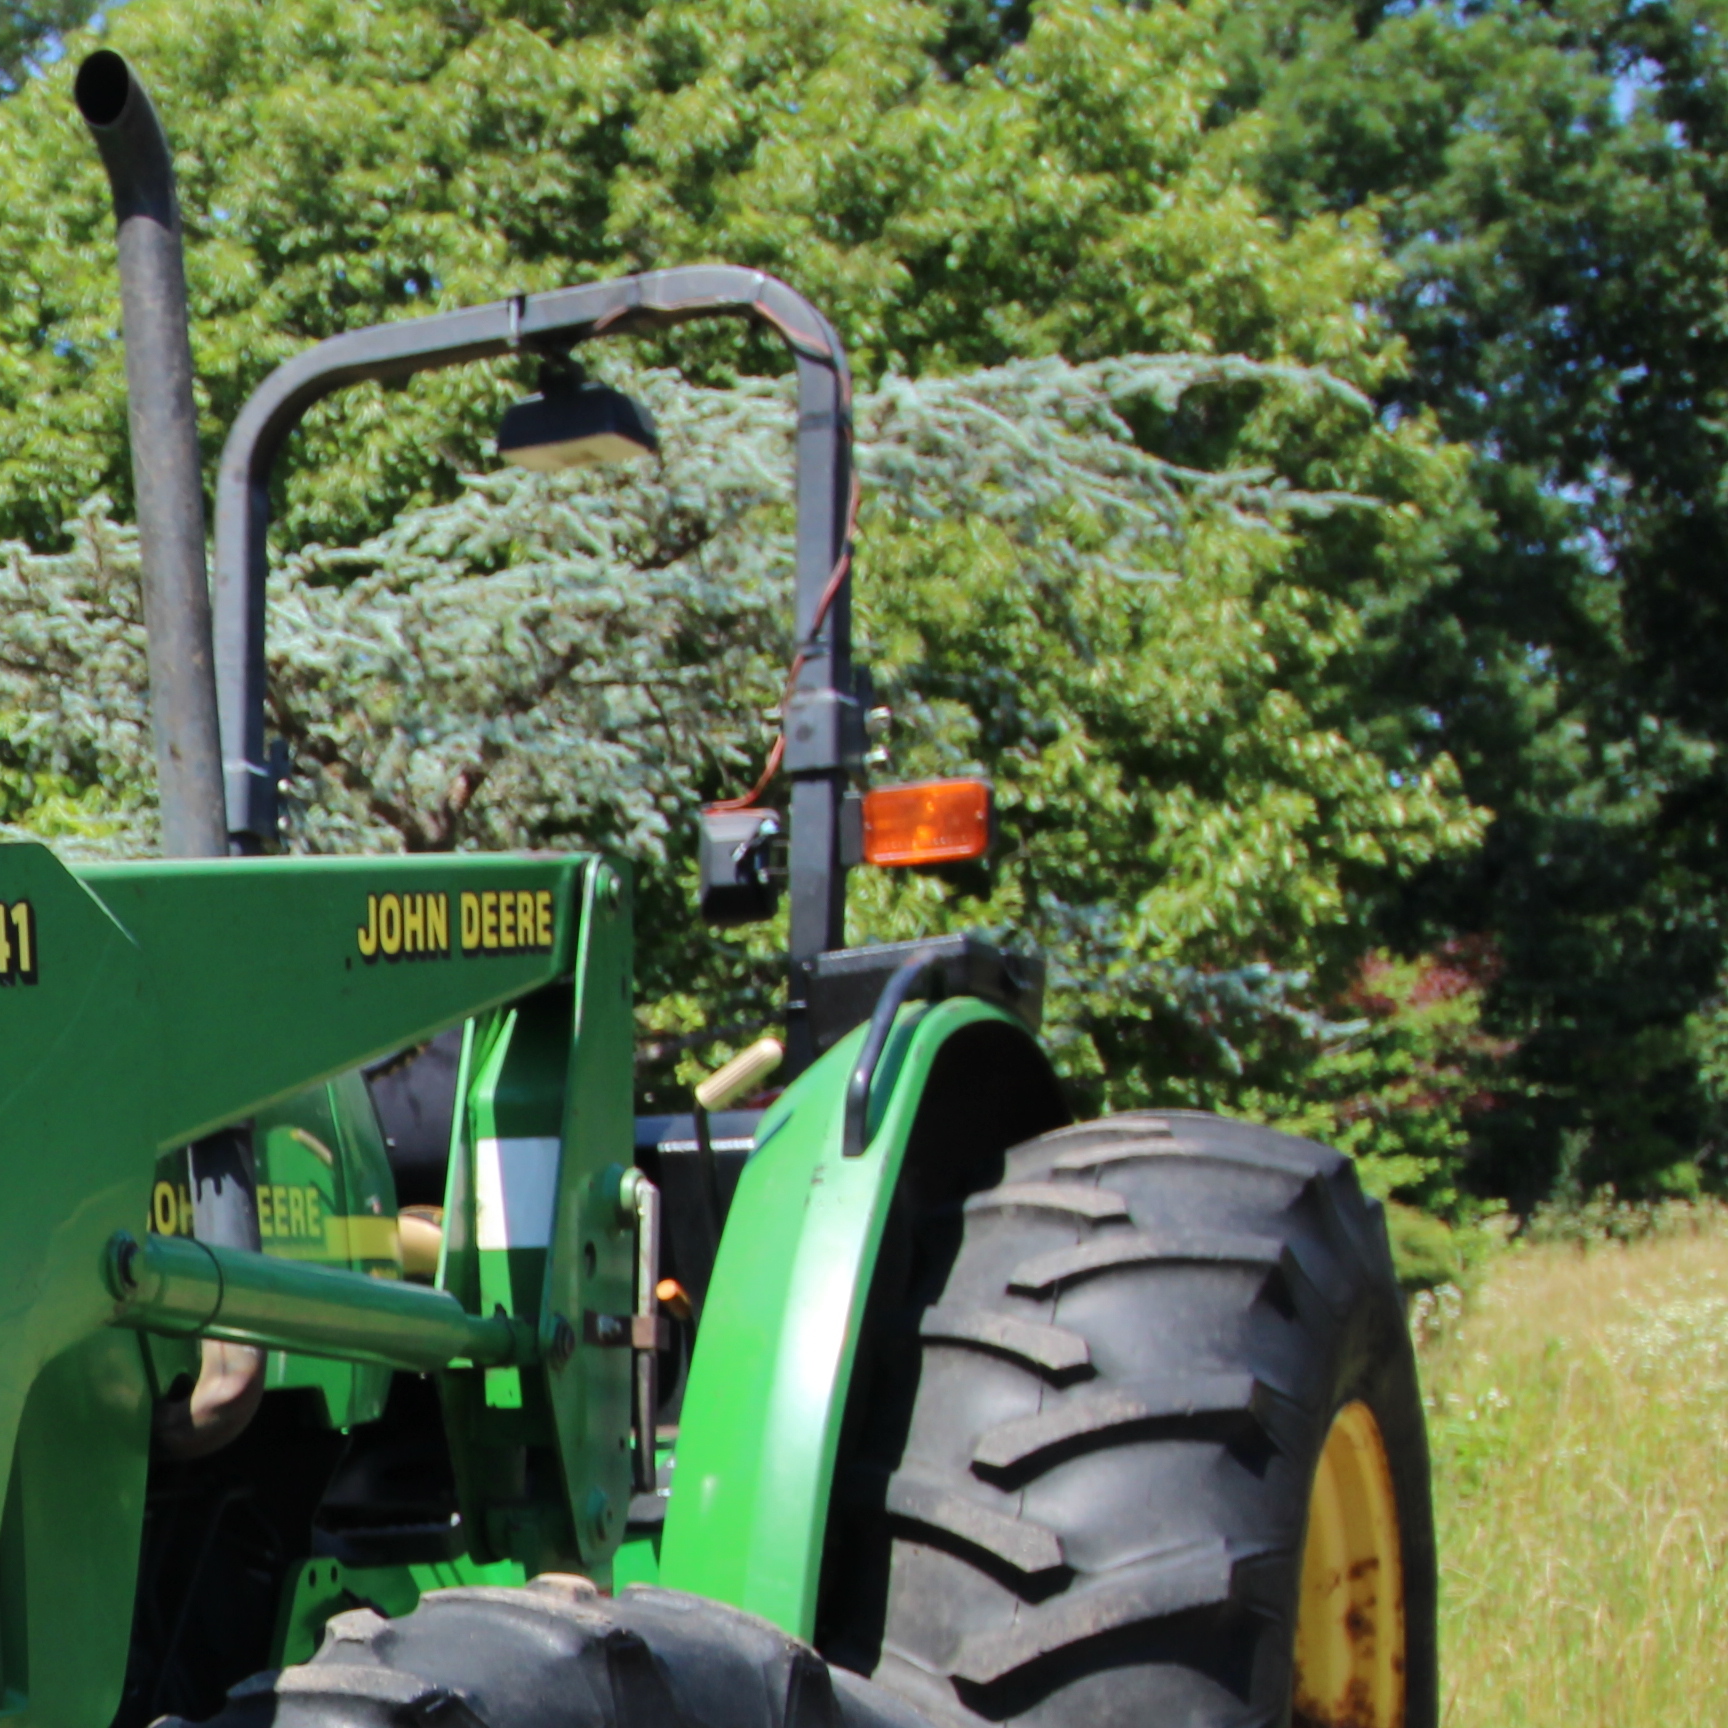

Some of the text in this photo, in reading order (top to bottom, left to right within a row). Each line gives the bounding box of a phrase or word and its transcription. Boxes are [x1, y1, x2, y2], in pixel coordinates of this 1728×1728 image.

[357, 890, 554, 957] JOHN DEERE
[255, 1184, 321, 1238] EERE
